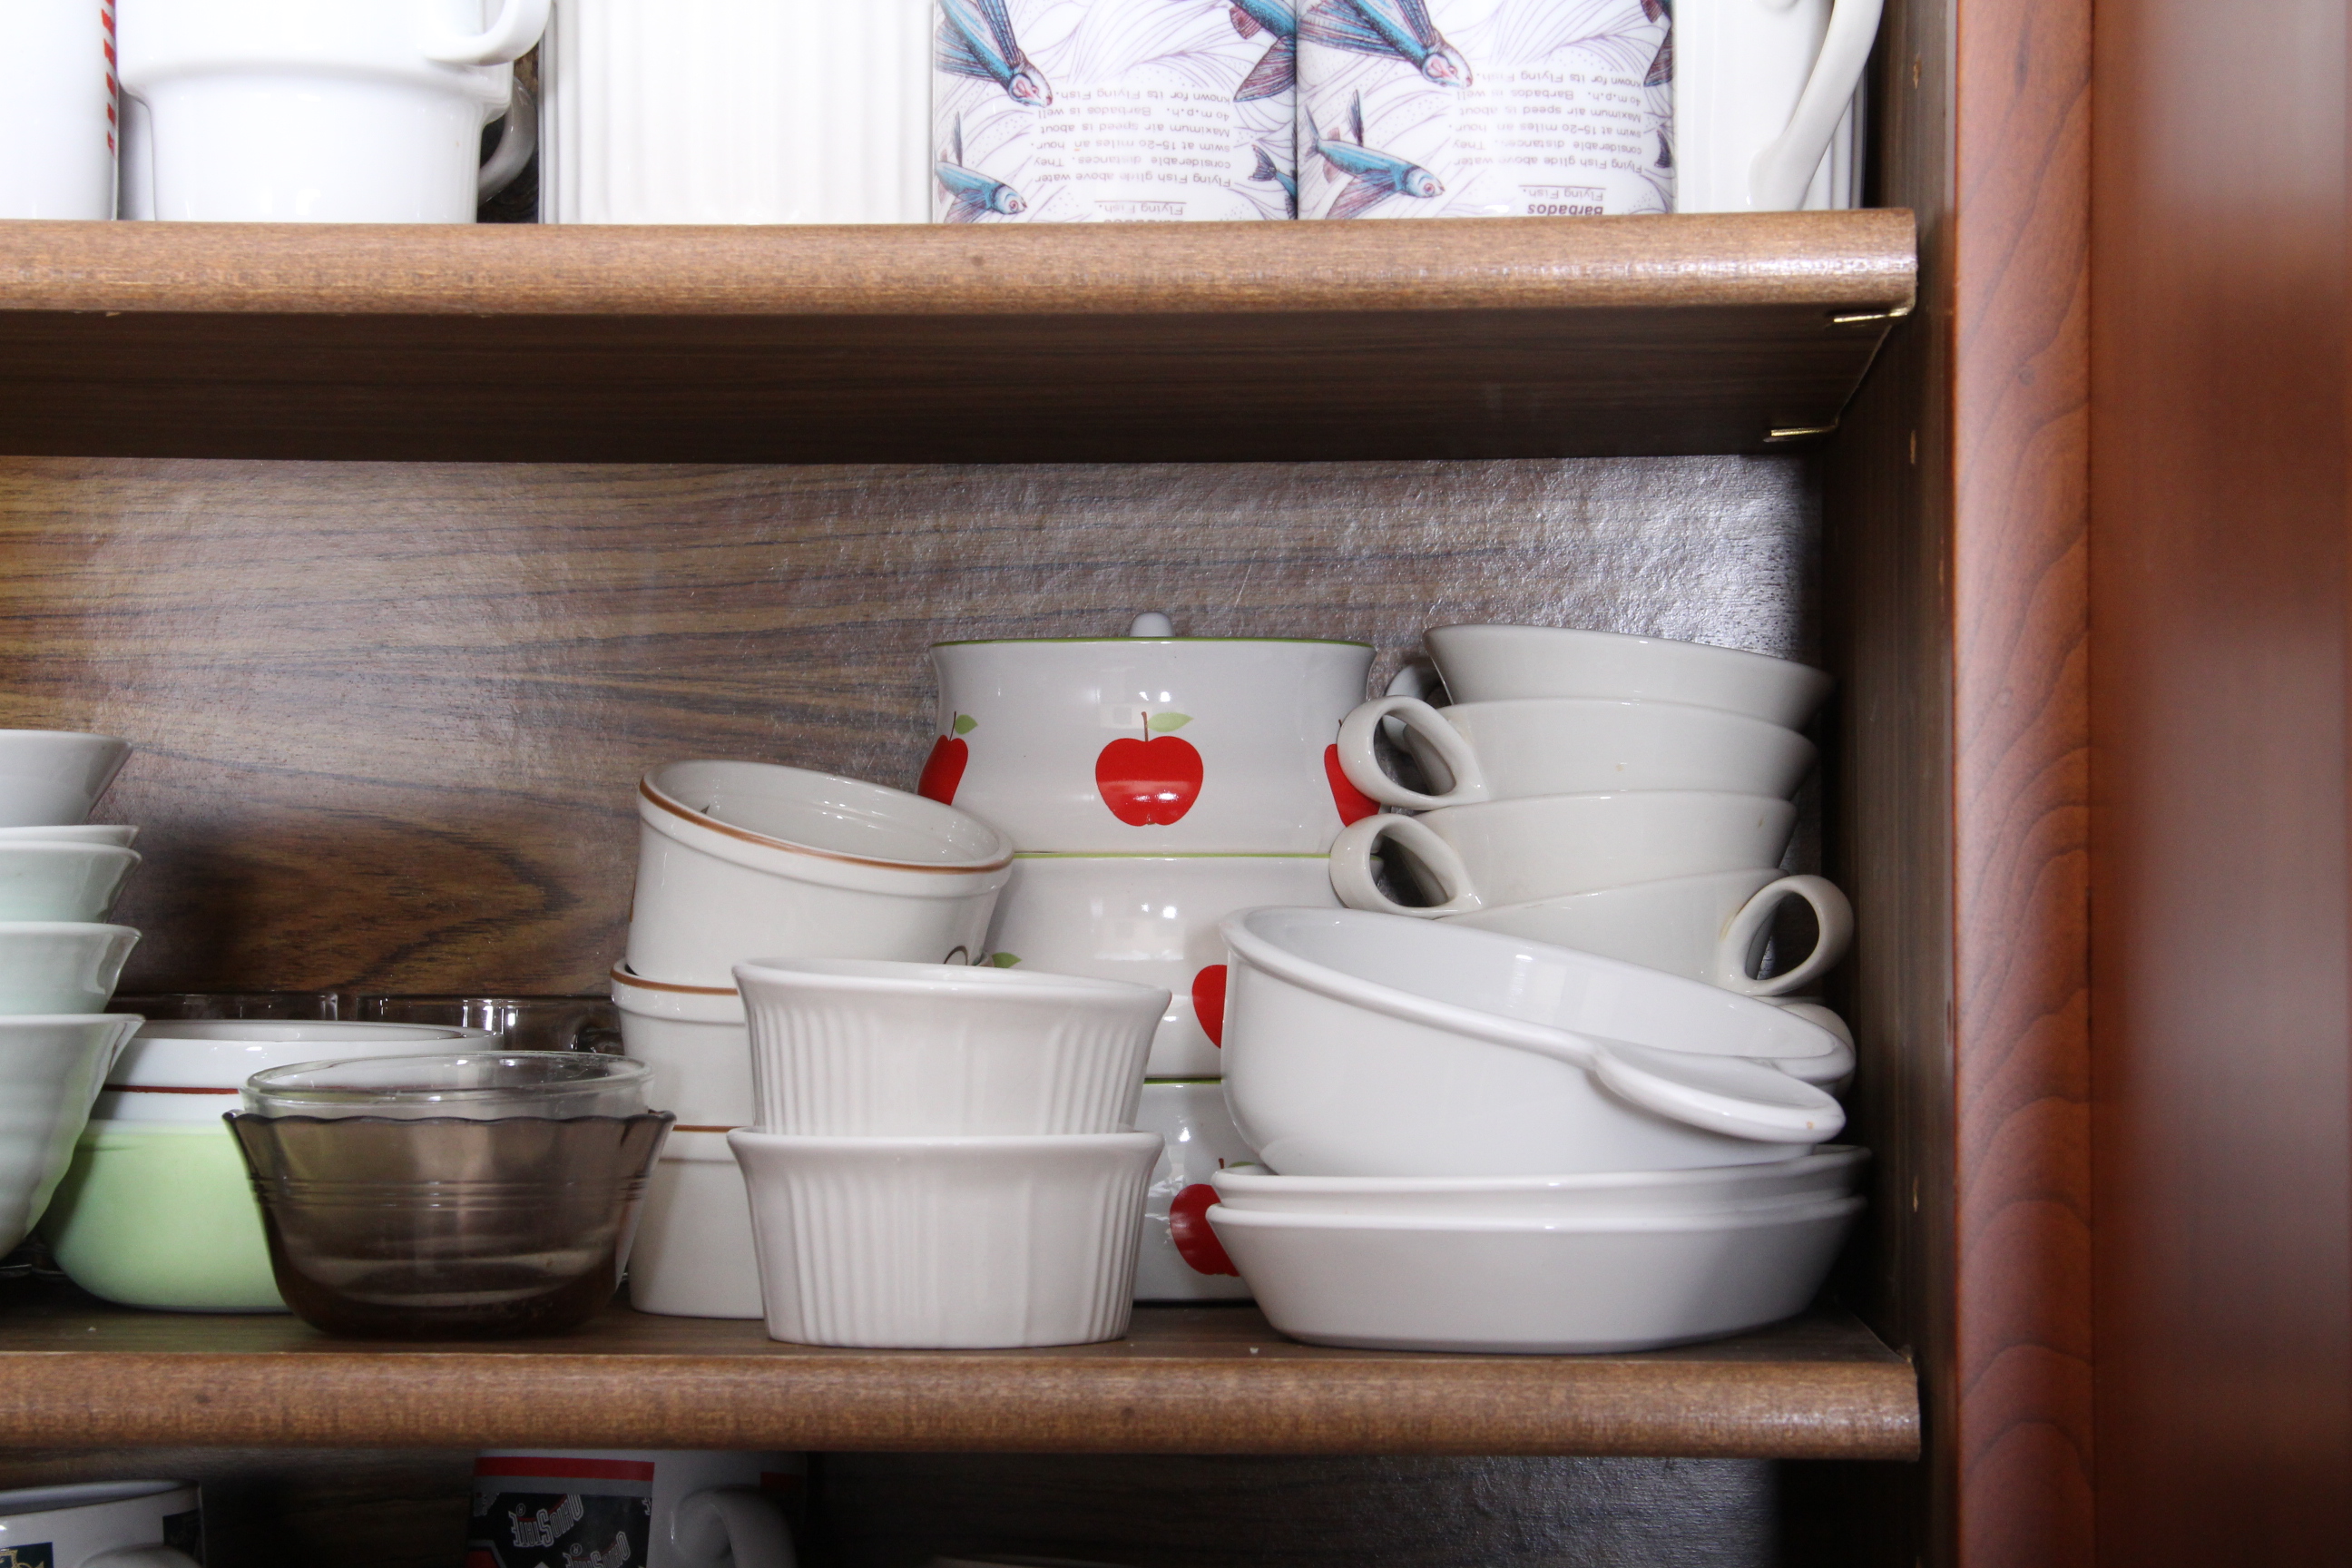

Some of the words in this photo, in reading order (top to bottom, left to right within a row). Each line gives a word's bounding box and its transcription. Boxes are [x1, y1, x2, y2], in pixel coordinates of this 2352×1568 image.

[1520, 71, 1563, 83] Flying
[1569, 74, 1585, 85] its
[1590, 75, 1608, 86] for
[1611, 77, 1642, 89] known
[1096, 89, 1141, 100] Flying
[1146, 91, 1164, 102] its
[1170, 93, 1189, 103] for
[1193, 93, 1230, 104] known
[1455, 90, 1486, 101] well
[1491, 90, 1504, 99] is
[1510, 89, 1574, 101] Barbados
[1037, 109, 1064, 119] well
[1069, 107, 1081, 117] is
[1086, 107, 1152, 116] Barbados
[1458, 107, 1498, 117] about
[1504, 106, 1517, 117] is
[1522, 105, 1562, 117] speed
[1566, 107, 1586, 118] air
[1590, 108, 1642, 123] Maximum
[1040, 124, 1075, 134] about
[1082, 123, 1093, 133] is
[1099, 122, 1139, 132] speed
[1143, 123, 1164, 134] air
[1170, 124, 1230, 137] Maximum
[1497, 123, 1514, 132] an
[1519, 122, 1558, 133] miles
[1600, 126, 1613, 137] at
[1616, 127, 1642, 139] swim
[1073, 141, 1091, 149] an
[1095, 140, 1134, 150] miles
[1181, 142, 1195, 152] at
[1200, 143, 1230, 152] swim
[1452, 140, 1486, 151] They
[1573, 141, 1642, 155] considerable
[1033, 157, 1063, 167] They
[1151, 156, 1231, 170] considerable
[1453, 157, 1494, 167] water
[1498, 157, 1538, 167] above
[1543, 155, 1575, 167] glide
[1580, 158, 1607, 170] Fish
[1611, 159, 1642, 173] Flying
[1034, 174, 1071, 183] water
[1075, 172, 1114, 183] above
[1119, 171, 1153, 183] glide
[1157, 173, 1188, 183] Fish
[1193, 172, 1231, 187] Flying
[1563, 188, 1603, 201] Flying
[1140, 202, 1183, 215] Flying
[1527, 203, 1603, 216] Barbados
